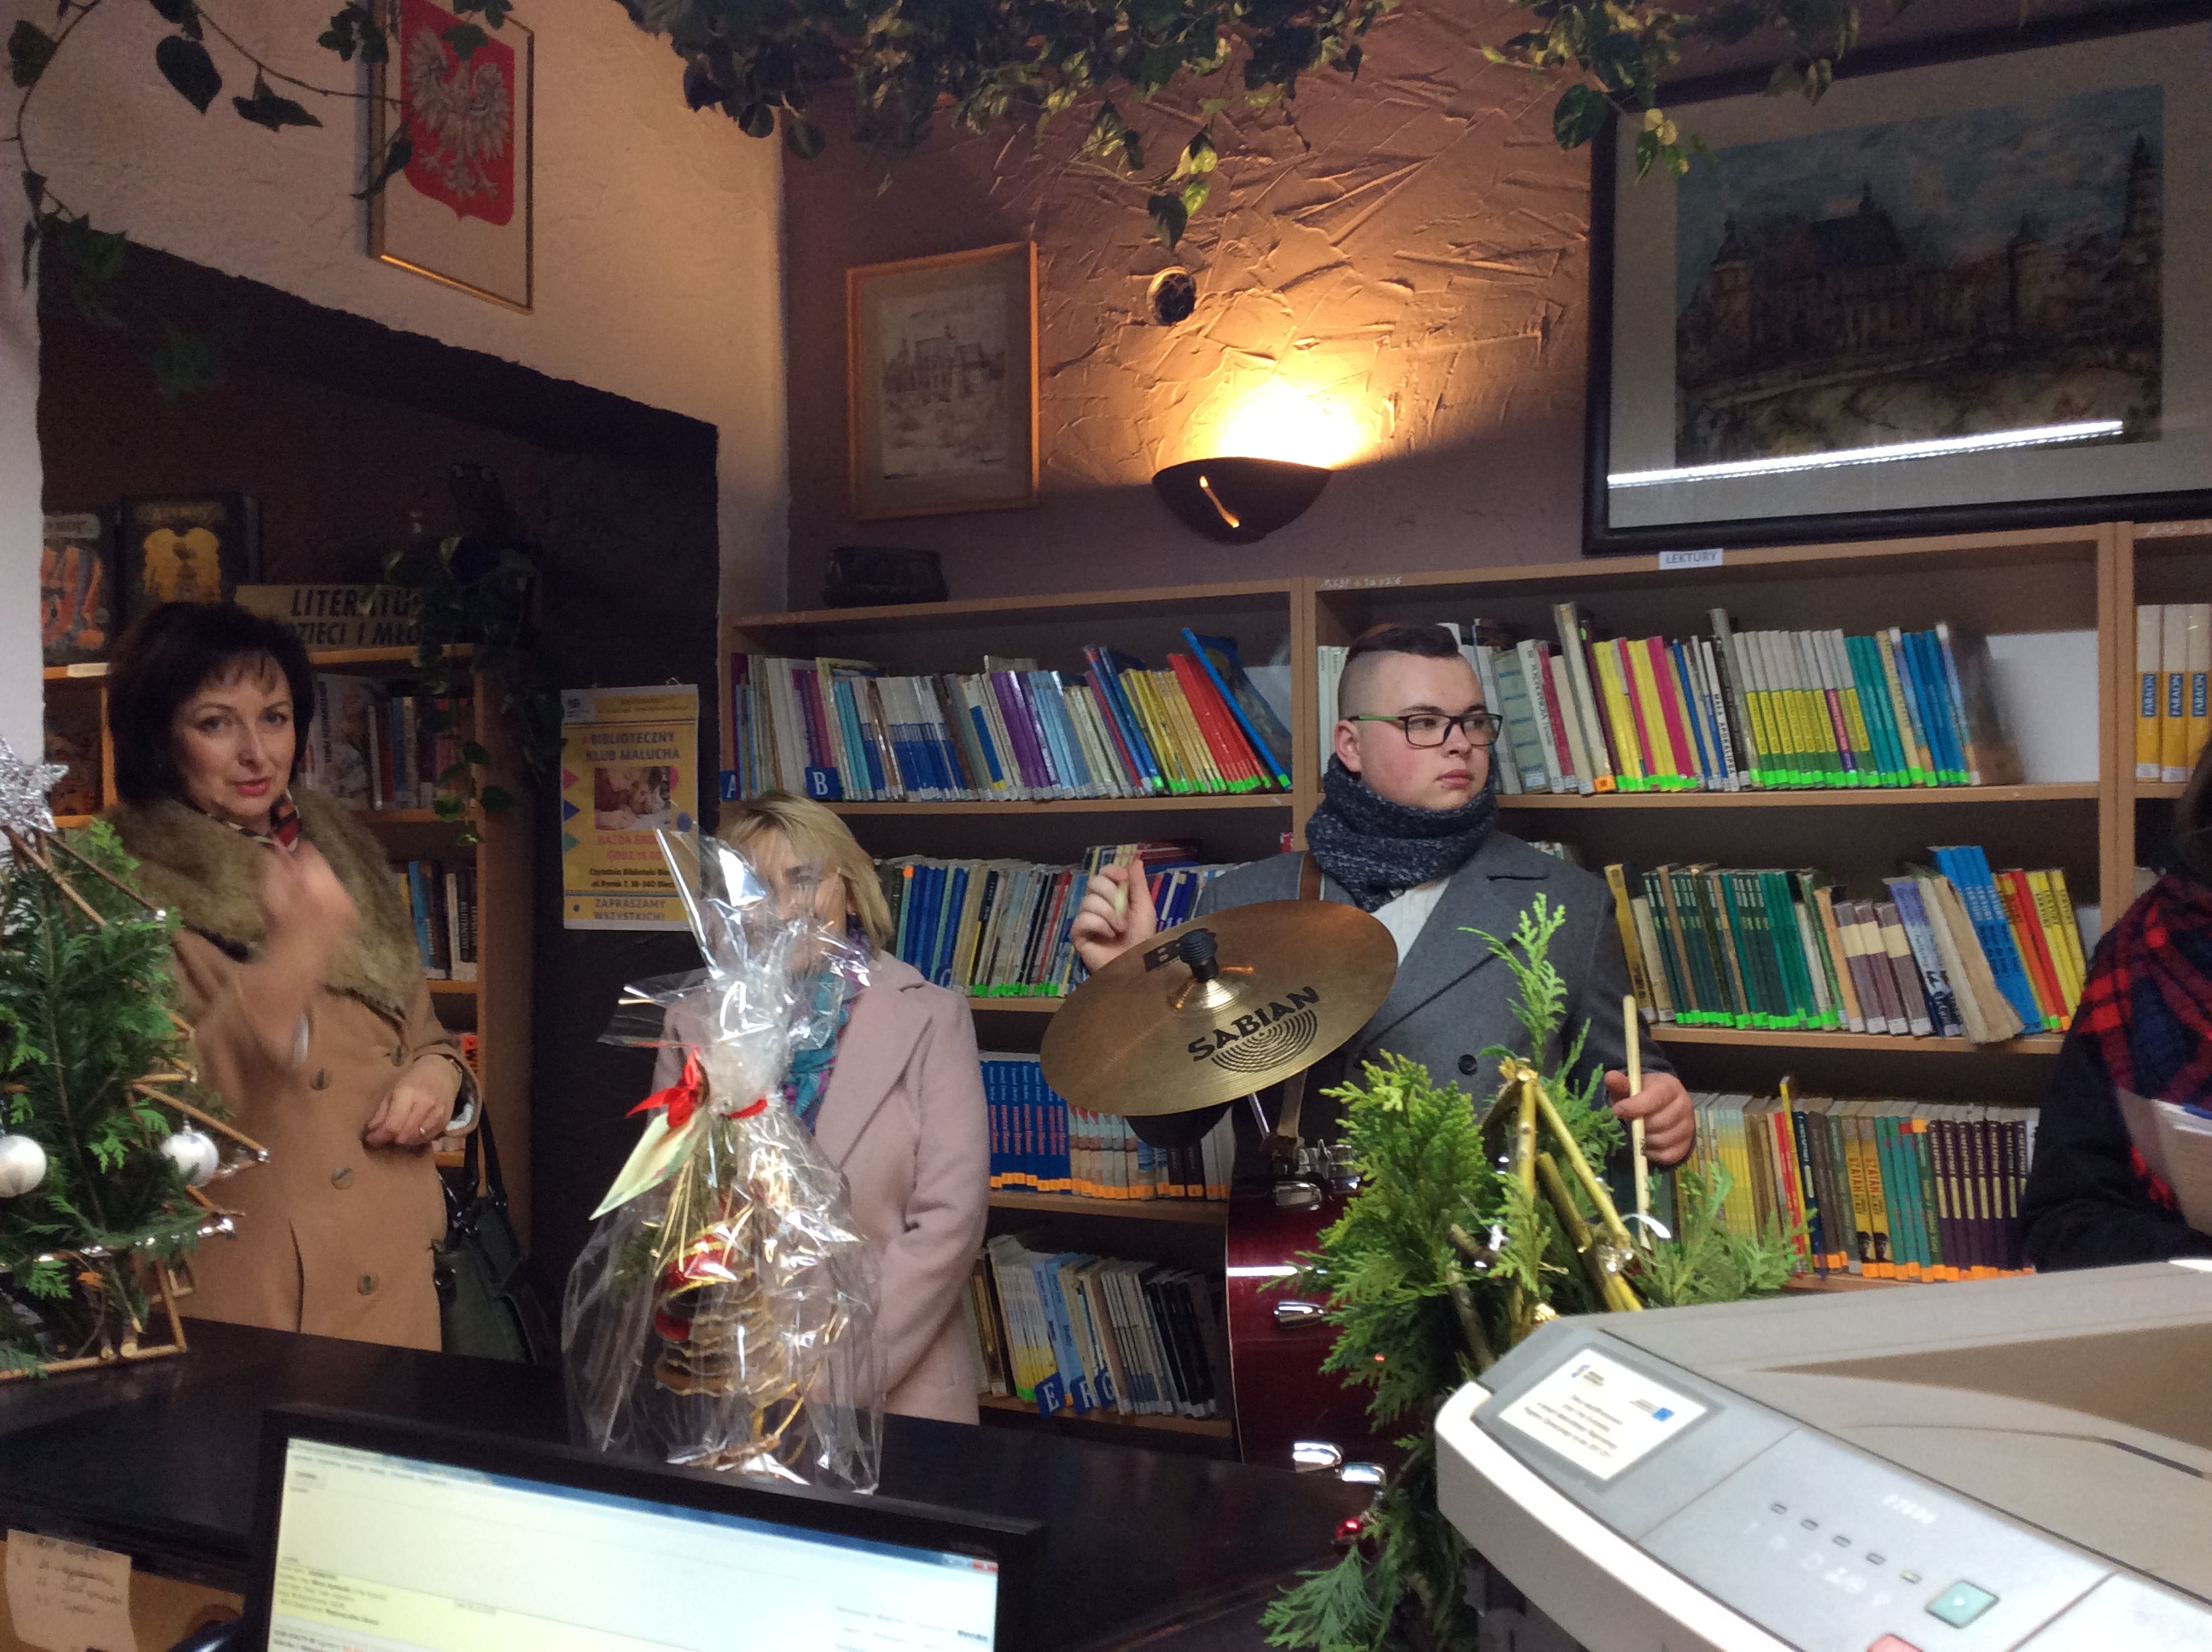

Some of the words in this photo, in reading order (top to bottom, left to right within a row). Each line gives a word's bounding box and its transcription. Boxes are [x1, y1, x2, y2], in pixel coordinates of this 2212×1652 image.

[1666, 550, 1718, 564] LEKTURY
[2144, 673, 2157, 717] FARAON
[2170, 673, 2183, 717] FARAON
[2194, 673, 2206, 717] FARAON
[591, 731, 675, 746] BIBLIOTECZNY
[1720, 722, 1736, 775] APOKALIPSA
[585, 749, 617, 762] KLUB
[620, 747, 680, 761] MALUCHA
[812, 771, 829, 795] B
[594, 911, 665, 921] WSZYSTKICH!
[595, 899, 666, 909] ZAPRASZAMY
[1188, 986, 1320, 1062] SABIAN
[1042, 1382, 1060, 1414] E
